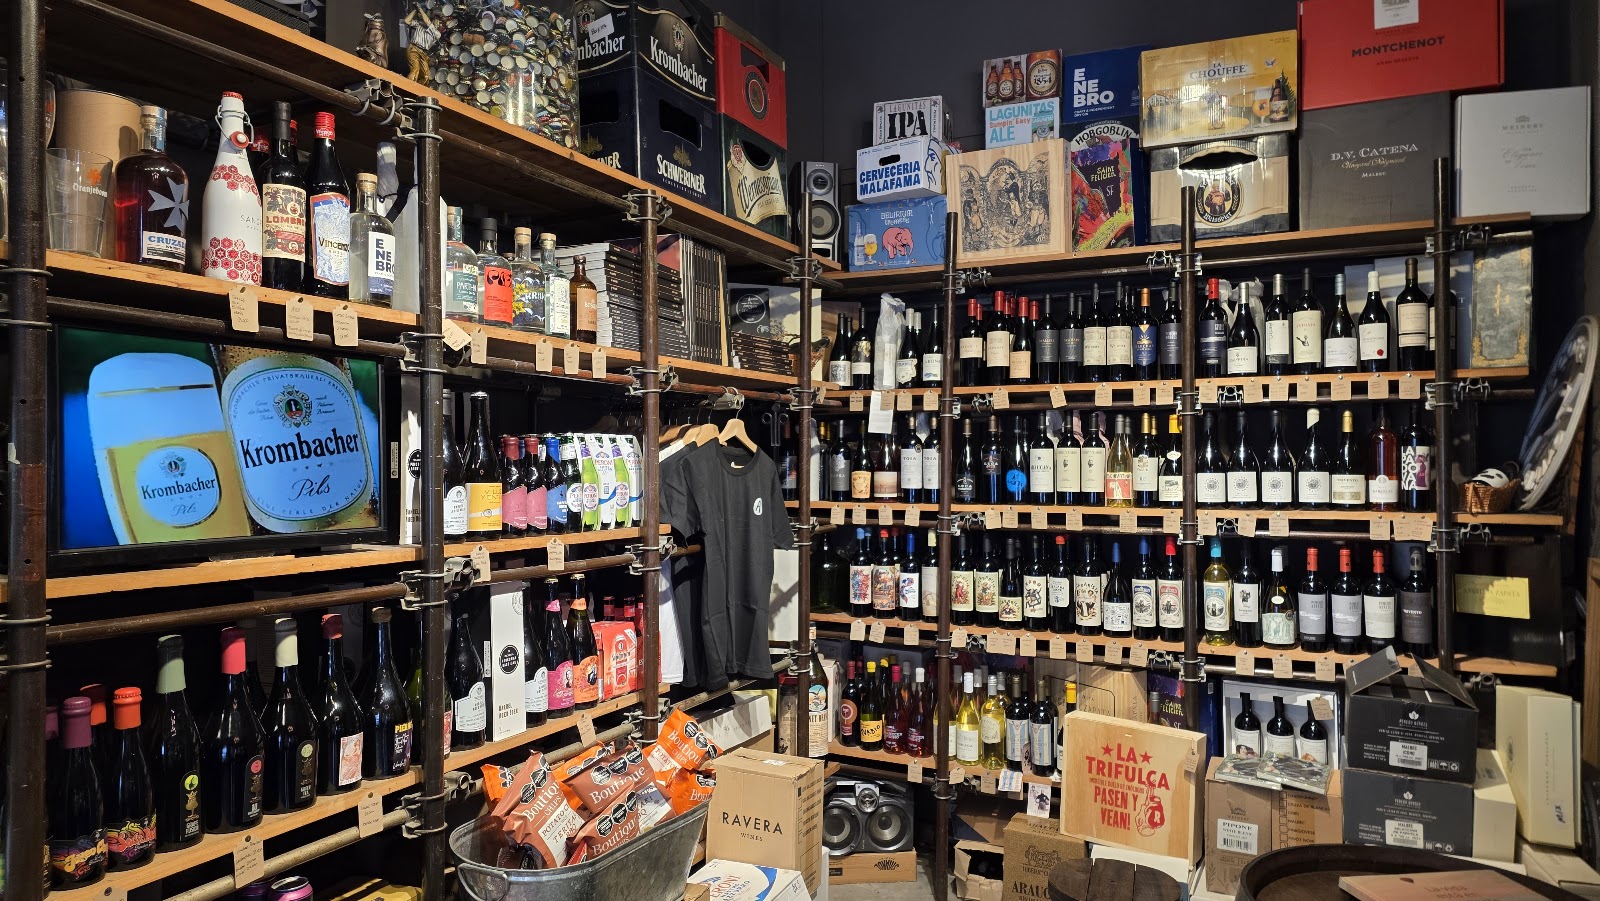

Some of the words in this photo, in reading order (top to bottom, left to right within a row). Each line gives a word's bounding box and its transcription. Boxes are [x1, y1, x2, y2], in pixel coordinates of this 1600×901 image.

[1351, 35, 1445, 57] MONTCHENOT
[650, 35, 707, 92] Krombacher
[1190, 64, 1247, 80] CHOUFFE
[1074, 68, 1086, 82] E
[1074, 79, 1099, 95] NE
[889, 100, 927, 113] LAGUNITAS
[1073, 91, 1115, 108] BRO
[989, 101, 1055, 121] LAGUNITAS
[1015, 117, 1031, 126] Easy
[887, 110, 929, 140] IPA
[990, 125, 1016, 144] ALE
[1076, 125, 1133, 146] HOBGOBLIN
[1330, 151, 1356, 161] D.V.
[1359, 143, 1419, 158] CATENA
[656, 153, 707, 195] SCHWERINER
[859, 160, 921, 184] CERVECERIA
[859, 173, 921, 196] MALAFAMA
[376, 238, 385, 250] E
[376, 250, 392, 262] NE
[239, 427, 360, 469] Krombacher
[141, 477, 216, 500] Krombacher
[288, 474, 331, 502] Pils
[170, 503, 197, 517] Pils
[667, 729, 702, 766] Boutiqu
[671, 749, 687, 765] CHIPS
[1116, 743, 1138, 764] LA
[1401, 743, 1418, 751] MALBEC
[1086, 755, 1170, 791] TRIFULCA
[521, 779, 560, 822] Boutiqu
[543, 793, 562, 817] CHIPS
[1094, 785, 1129, 810] PASEN
[1131, 793, 1139, 812] Y
[541, 810, 565, 838] POTATO
[721, 811, 783, 836] RAVERA
[1100, 807, 1131, 831] VEAN!
[1222, 821, 1253, 832] PIPONE
[740, 832, 763, 842] WINES
